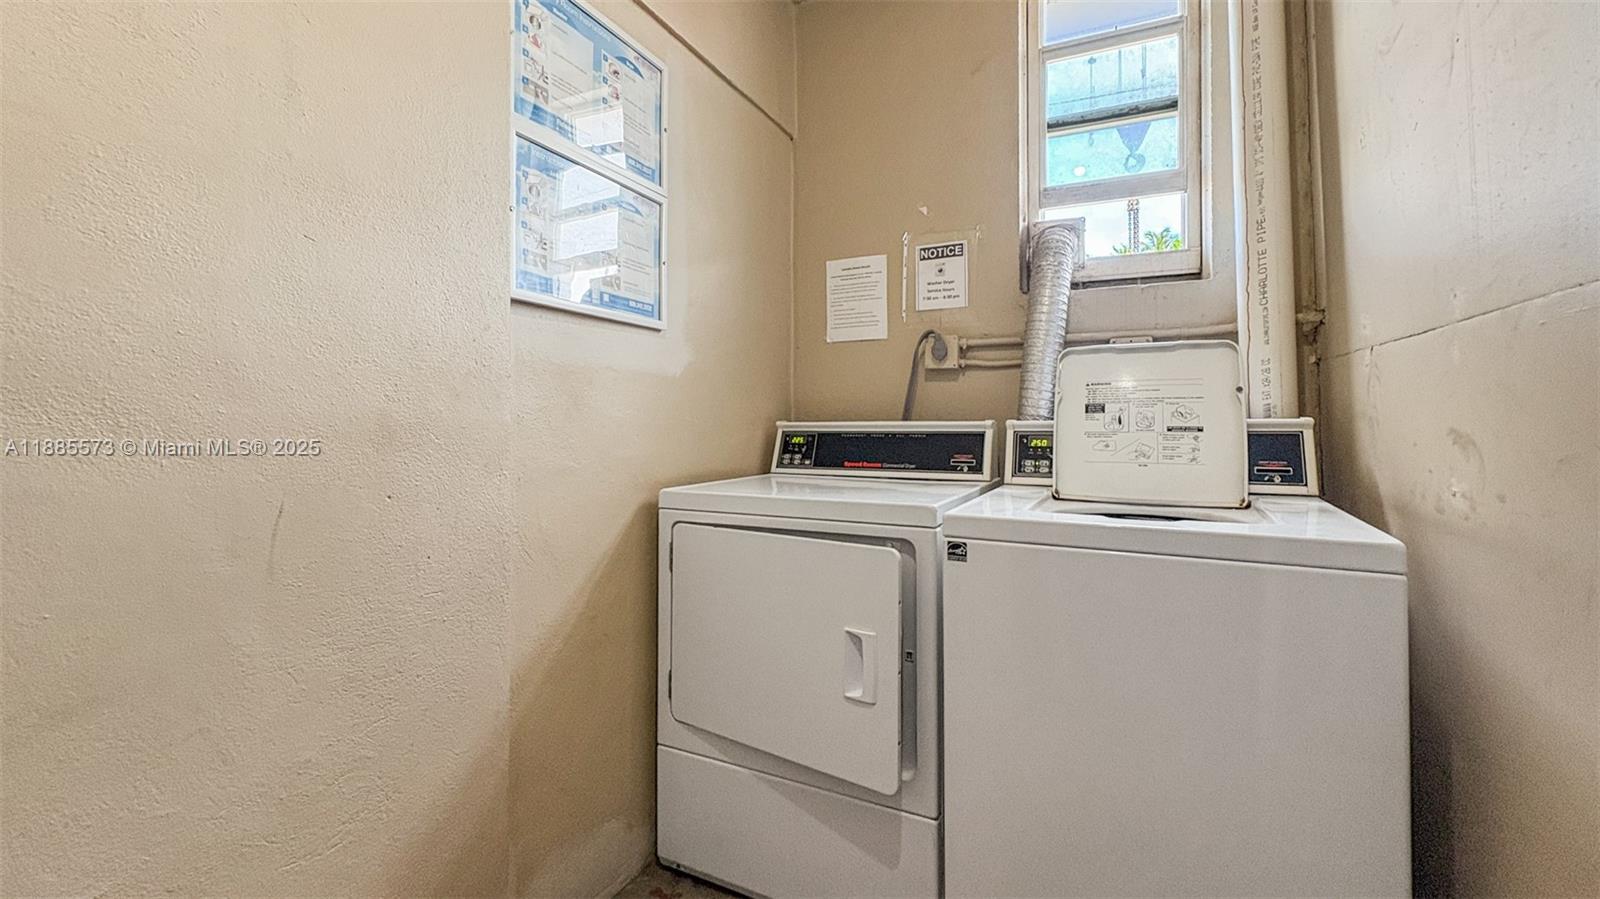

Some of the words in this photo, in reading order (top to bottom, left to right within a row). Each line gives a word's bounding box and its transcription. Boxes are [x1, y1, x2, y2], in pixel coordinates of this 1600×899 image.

[1255, 218, 1267, 244] PIPE
[920, 245, 962, 260] NOTICE
[1256, 248, 1269, 306] CHARLOTTE
[1030, 439, 1048, 447] 250
